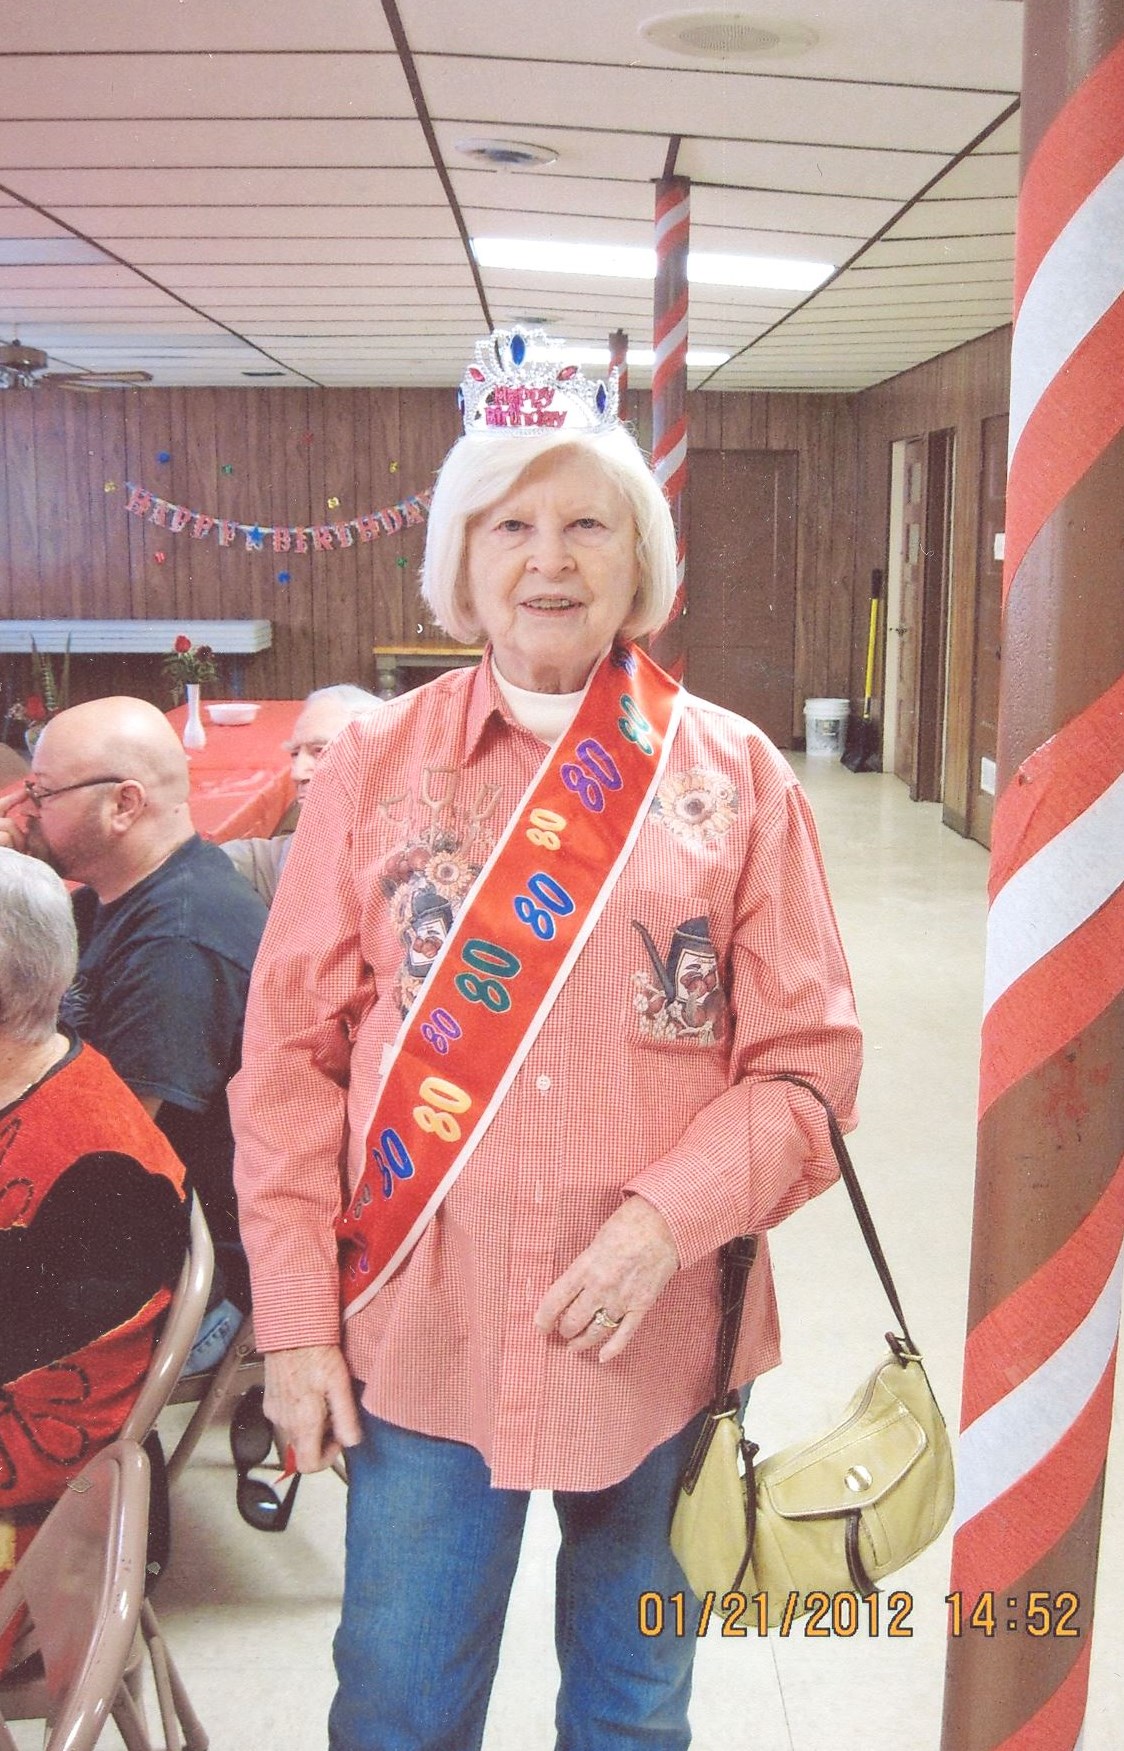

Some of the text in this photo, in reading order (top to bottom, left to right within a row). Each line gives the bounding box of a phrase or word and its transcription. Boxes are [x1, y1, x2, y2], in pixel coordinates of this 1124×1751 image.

[484, 403, 568, 428] Birthday
[494, 385, 556, 410] Happy
[618, 693, 654, 756] 80
[560, 737, 623, 813] 80
[526, 807, 567, 851] 80
[513, 871, 576, 941] 80
[454, 938, 521, 1013] 80
[421, 1007, 462, 1055] 80
[413, 1076, 472, 1142] 80
